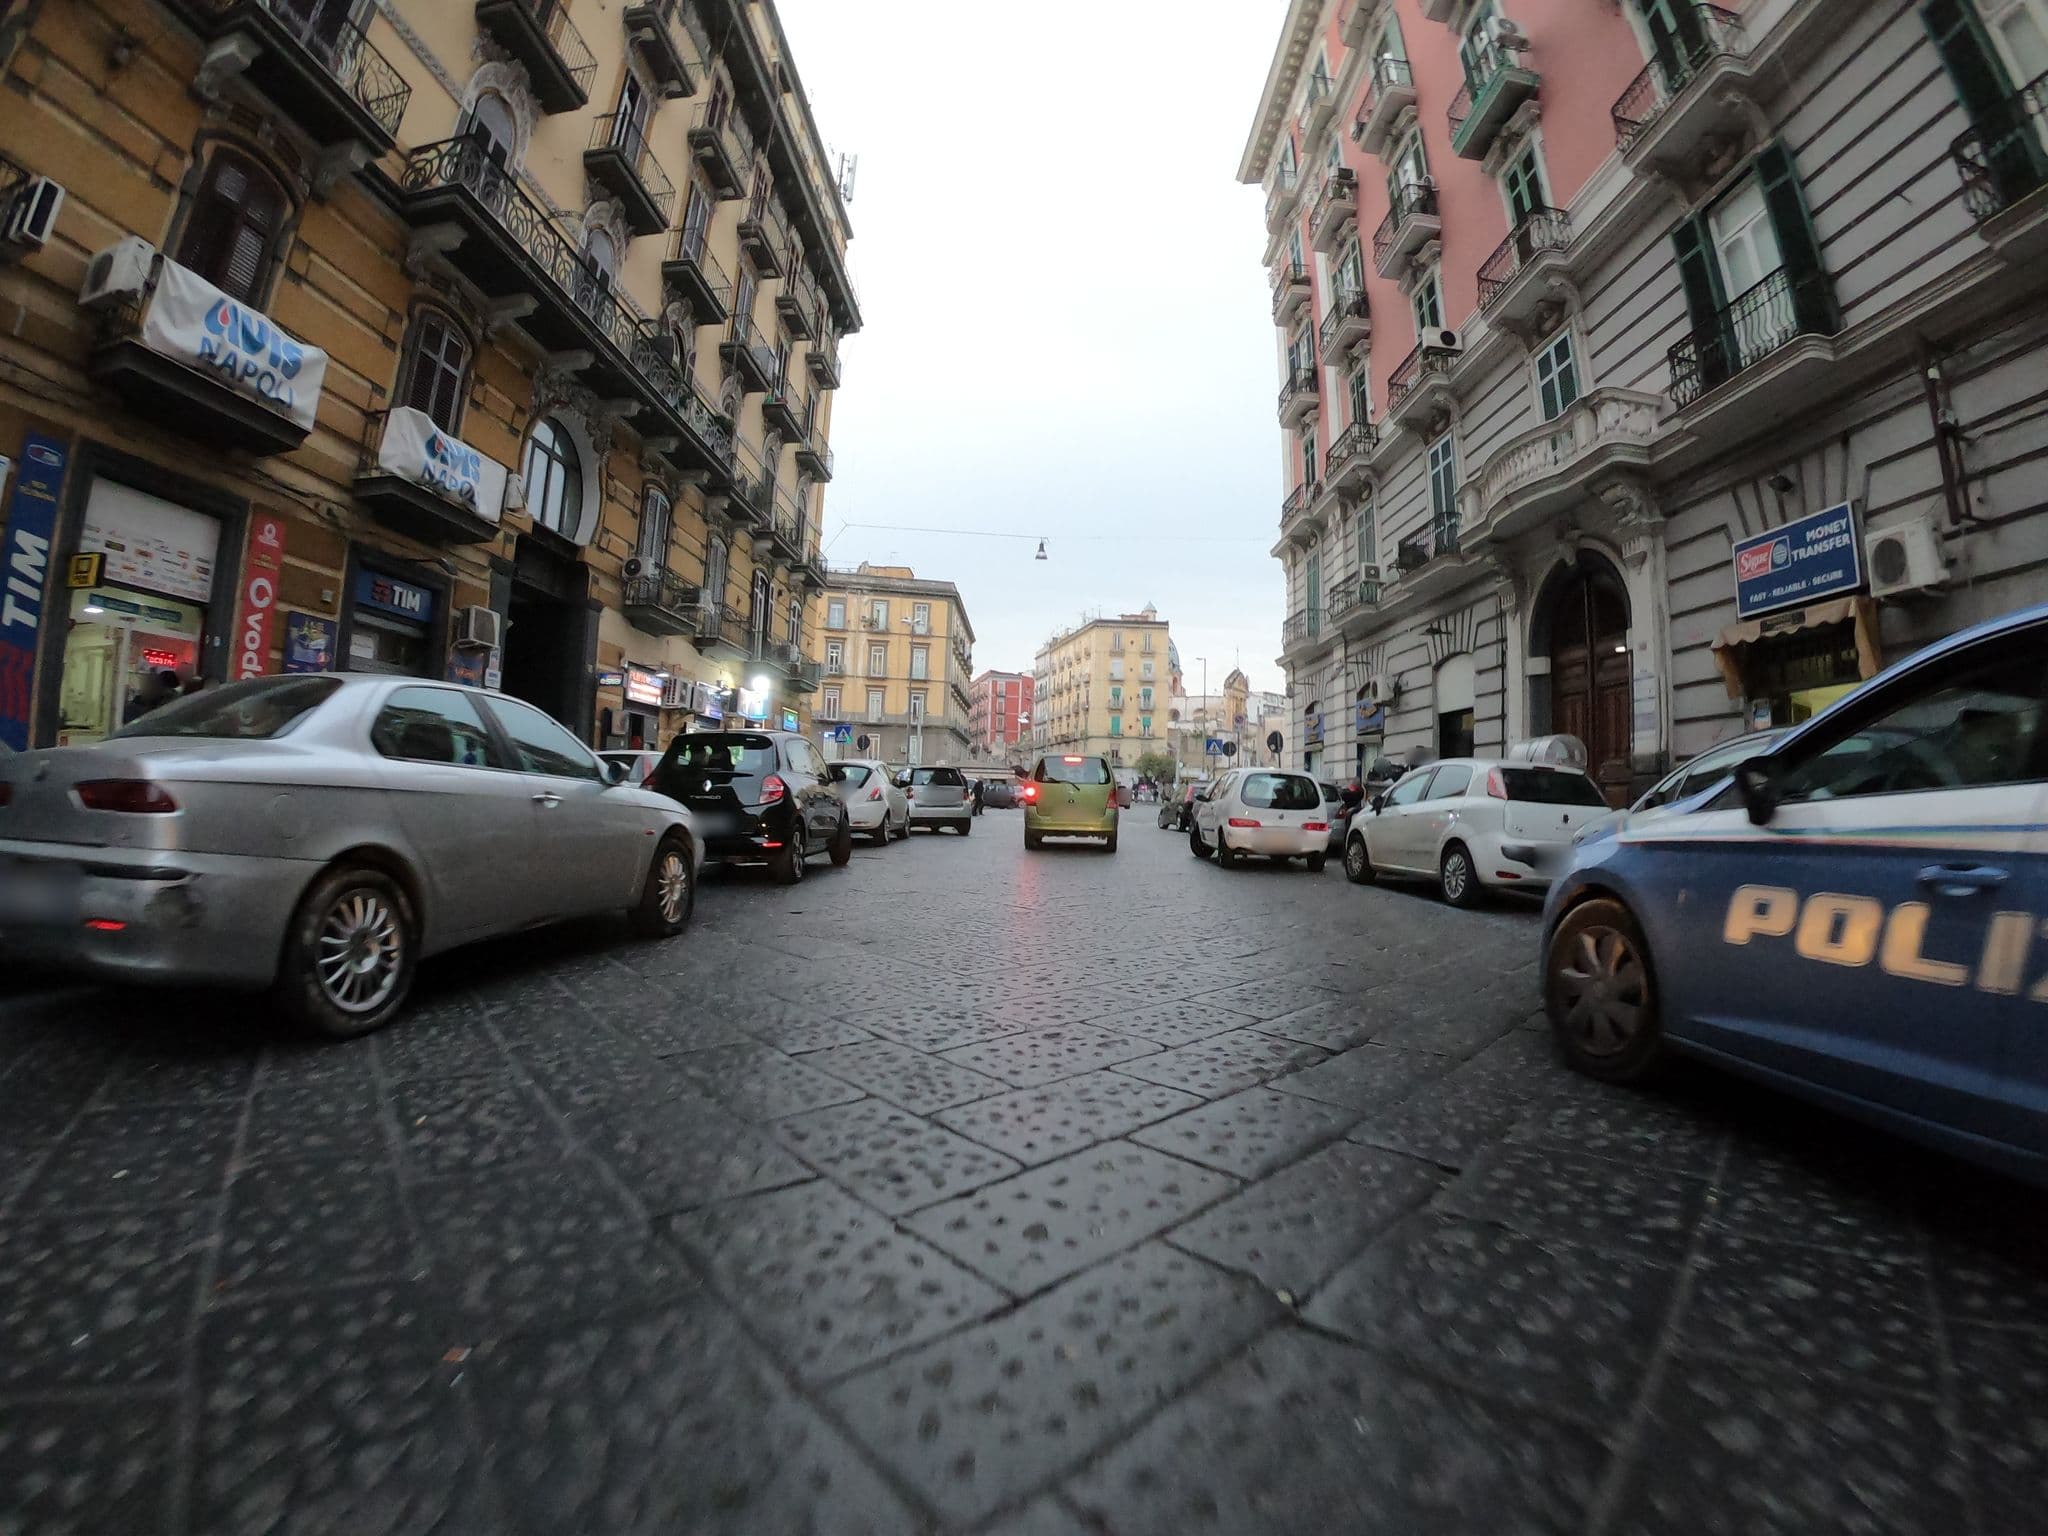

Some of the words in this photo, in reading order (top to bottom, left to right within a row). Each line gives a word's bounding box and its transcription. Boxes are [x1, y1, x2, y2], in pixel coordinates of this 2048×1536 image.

[204, 298, 304, 380] AVIS
[425, 428, 481, 483] AVIS
[1791, 534, 1851, 563] TRANSFER
[1806, 517, 1849, 541] MONEY
[2, 528, 49, 629] TIM
[392, 585, 421, 612] TIM
[1749, 592, 1766, 604] FAST
[1772, 580, 1807, 596] RELIABLE
[1812, 569, 1843, 585] SECURE
[1723, 883, 2048, 1003] POLI
